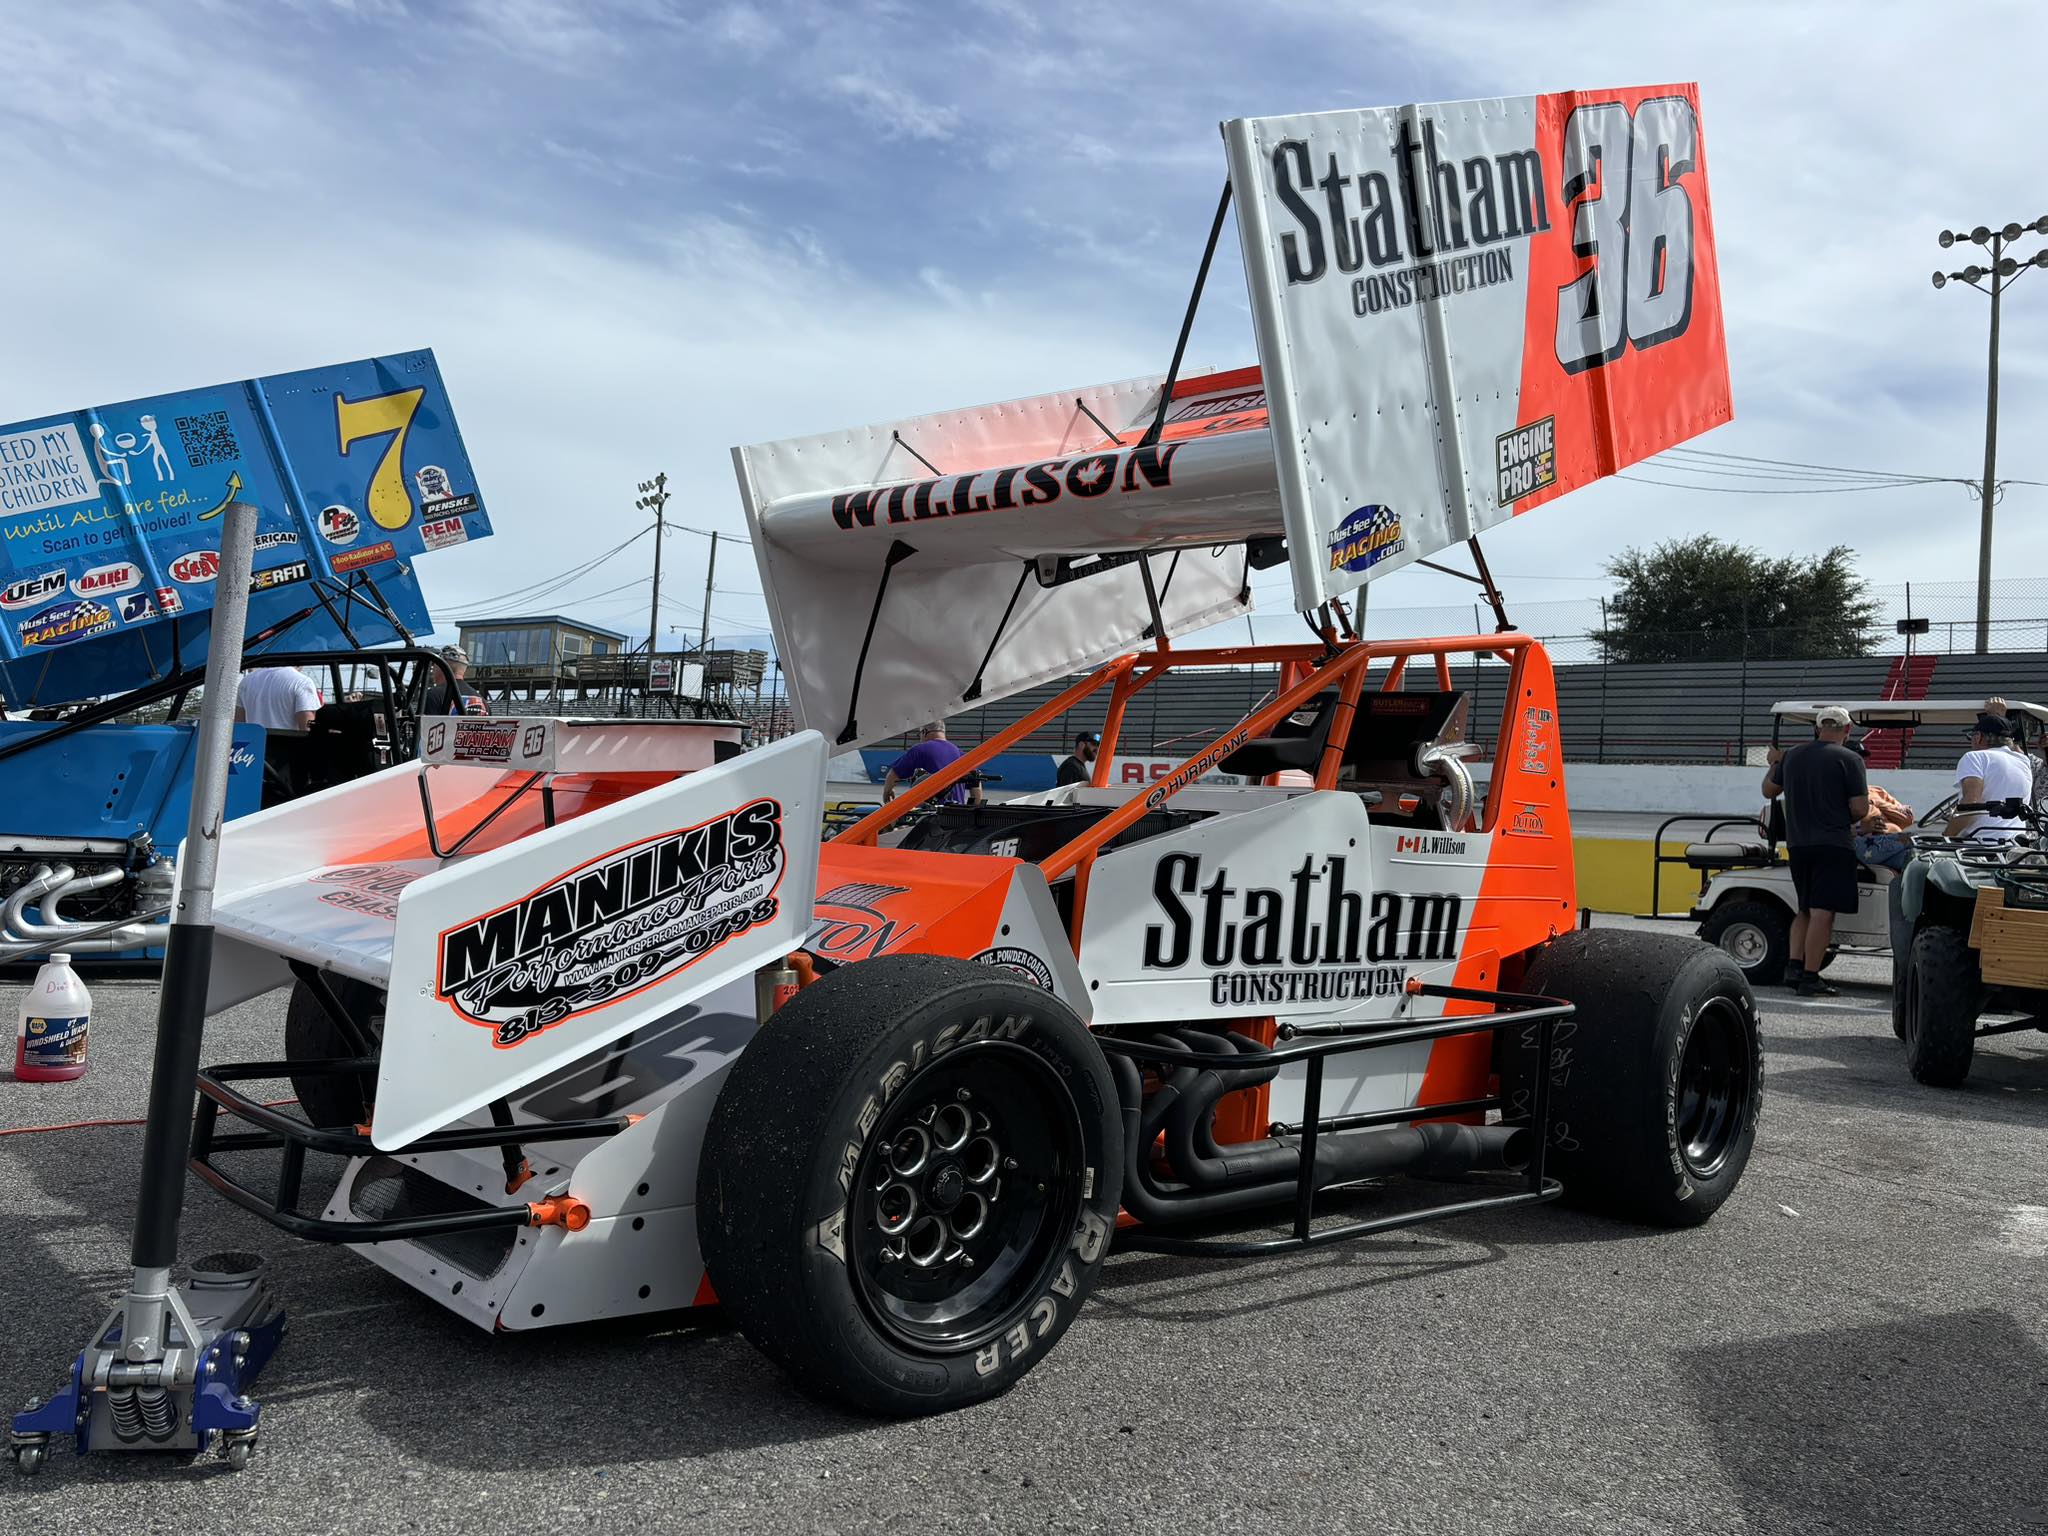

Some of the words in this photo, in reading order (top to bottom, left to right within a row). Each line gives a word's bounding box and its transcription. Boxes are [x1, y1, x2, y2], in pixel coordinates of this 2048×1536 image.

[1271, 118, 1551, 286] Statham
[1555, 95, 1698, 376] 36
[1351, 246, 1514, 318] CONSTRUCTION
[41, 431, 70, 453] MY
[333, 386, 425, 532] 7
[1499, 421, 1553, 470] ENGINE
[1, 475, 88, 510] CHILDREN
[831, 443, 1187, 530] WILLISON
[1500, 461, 1533, 500] PRO
[70, 506, 121, 526] ALL
[124, 500, 155, 516] are
[427, 497, 470, 513] PENSKE
[42, 538, 81, 554] Scan
[84, 531, 99, 545] to
[102, 525, 126, 545] get
[129, 512, 192, 536] involved!
[421, 518, 462, 538] PEM
[1330, 525, 1352, 546] Must
[1353, 519, 1370, 533] See
[1331, 521, 1400, 570] RACING
[1377, 541, 1404, 561] .com
[8, 572, 66, 600] UEM
[19, 617, 48, 633] Must
[50, 609, 70, 622] See
[23, 608, 112, 647] RACING
[83, 621, 117, 637] .com
[454, 731, 515, 748] STATHAM
[469, 748, 507, 756] RACING
[525, 728, 543, 755] 36
[1168, 729, 1249, 794] HURRICANE
[1514, 815, 1543, 830] DUTTON
[991, 839, 1018, 857] 36
[440, 802, 780, 993] MANIKIS
[1143, 853, 1461, 969] Statham
[463, 897, 686, 1012] Performance
[682, 850, 777, 910] Parts
[497, 898, 776, 1045] 813-309-0798
[997, 950, 1027, 964] POWDER
[1027, 956, 1052, 989] COATING
[1211, 967, 1405, 1005] CONSTRUCTION
[27, 1031, 69, 1048] WINDSHIELD
[816, 1014, 1032, 1264] AMERICAN
[974, 1209, 1111, 1377] RACER
